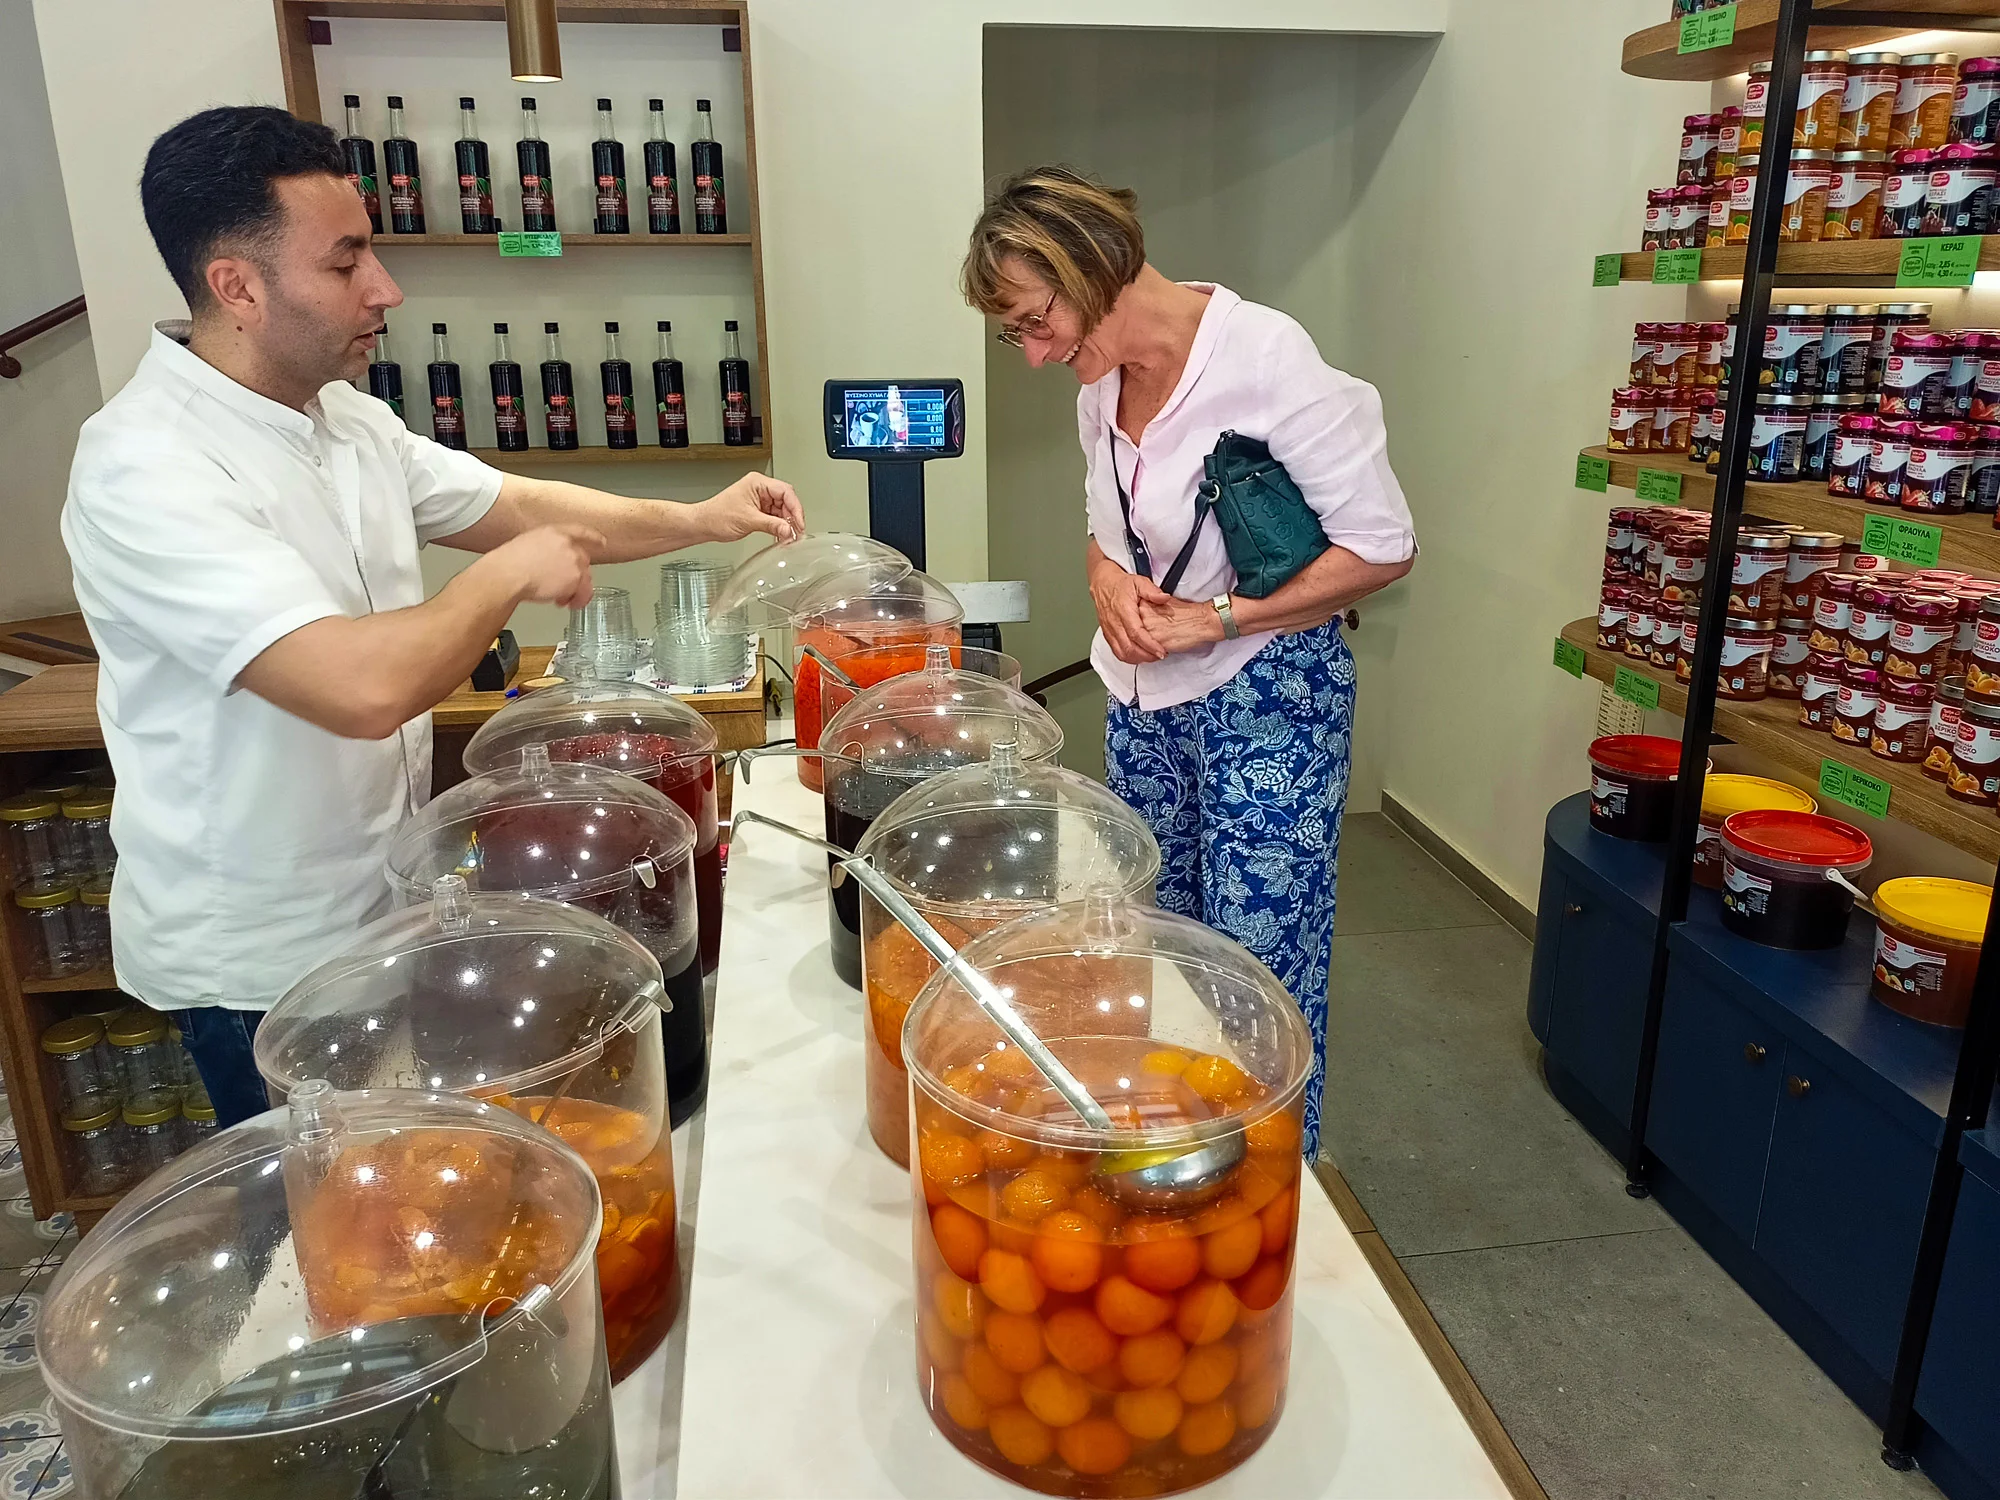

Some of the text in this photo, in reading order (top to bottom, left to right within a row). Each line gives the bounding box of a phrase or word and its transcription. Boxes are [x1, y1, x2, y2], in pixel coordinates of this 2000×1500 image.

[1941, 242, 1964, 252] ΚΕΡΑΣΙ
[1898, 525, 1931, 539] ΦΡΑΟΥΛΑ
[1852, 774, 1882, 792] ΒΕΡΙΚΟΚΟ
